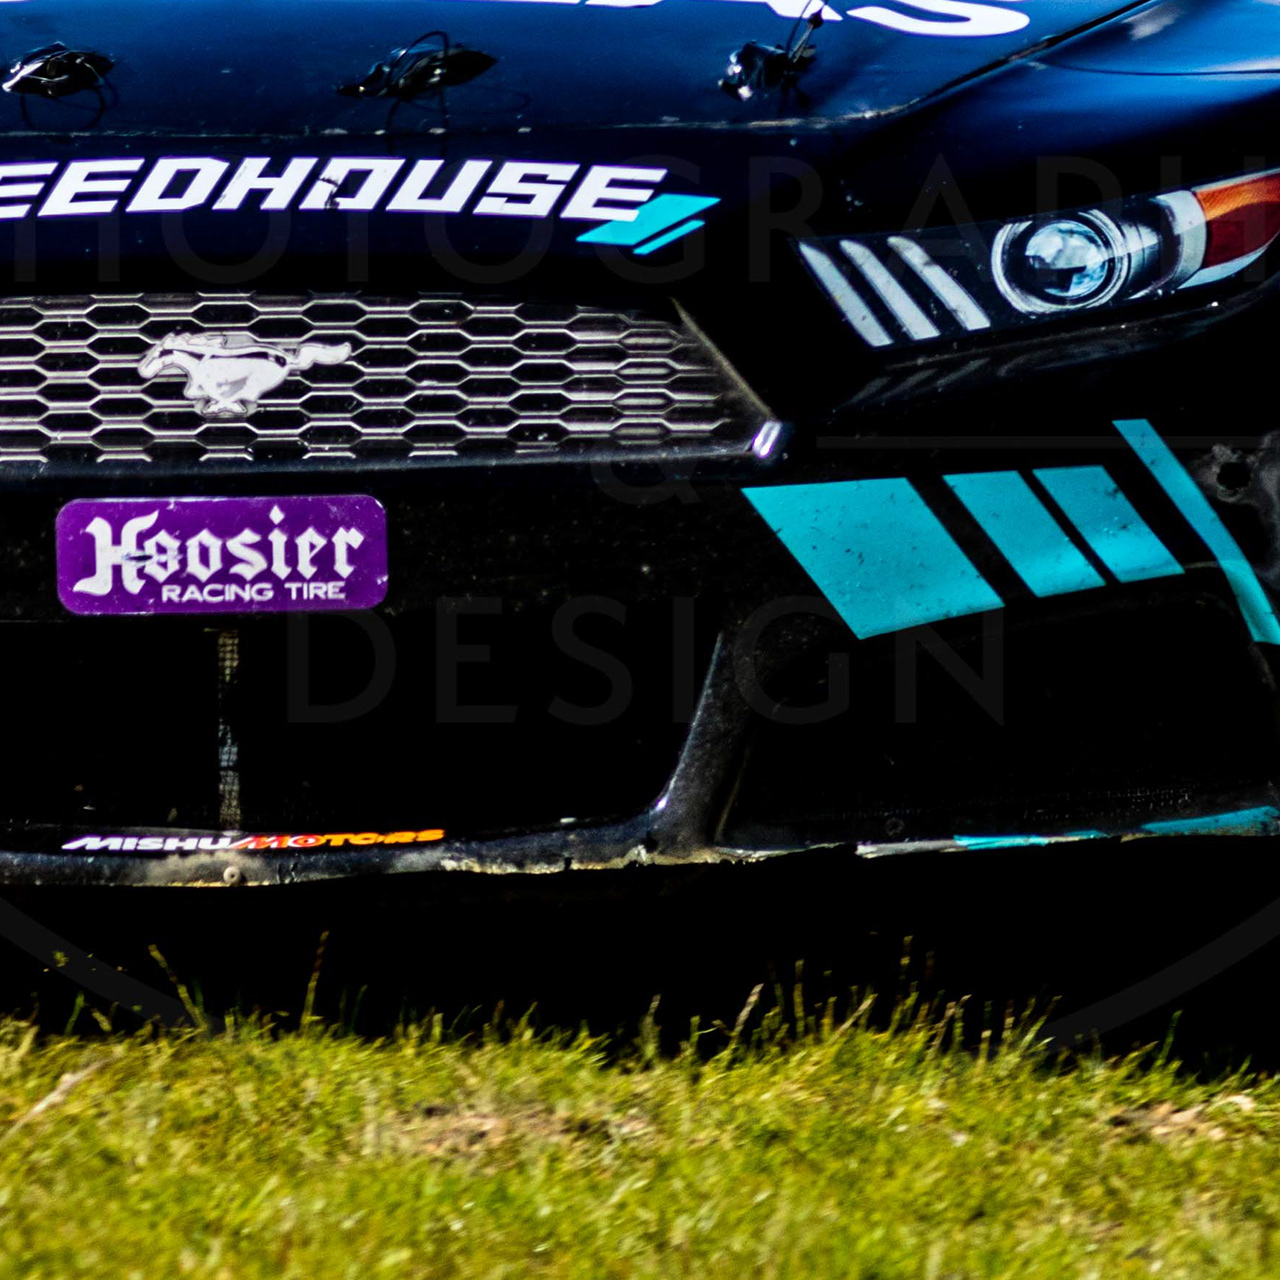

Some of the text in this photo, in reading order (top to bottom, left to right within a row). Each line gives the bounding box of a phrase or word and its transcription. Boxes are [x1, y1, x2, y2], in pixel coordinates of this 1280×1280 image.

[72, 504, 367, 598] Hoosier
[161, 581, 347, 605] RACING TIRE
